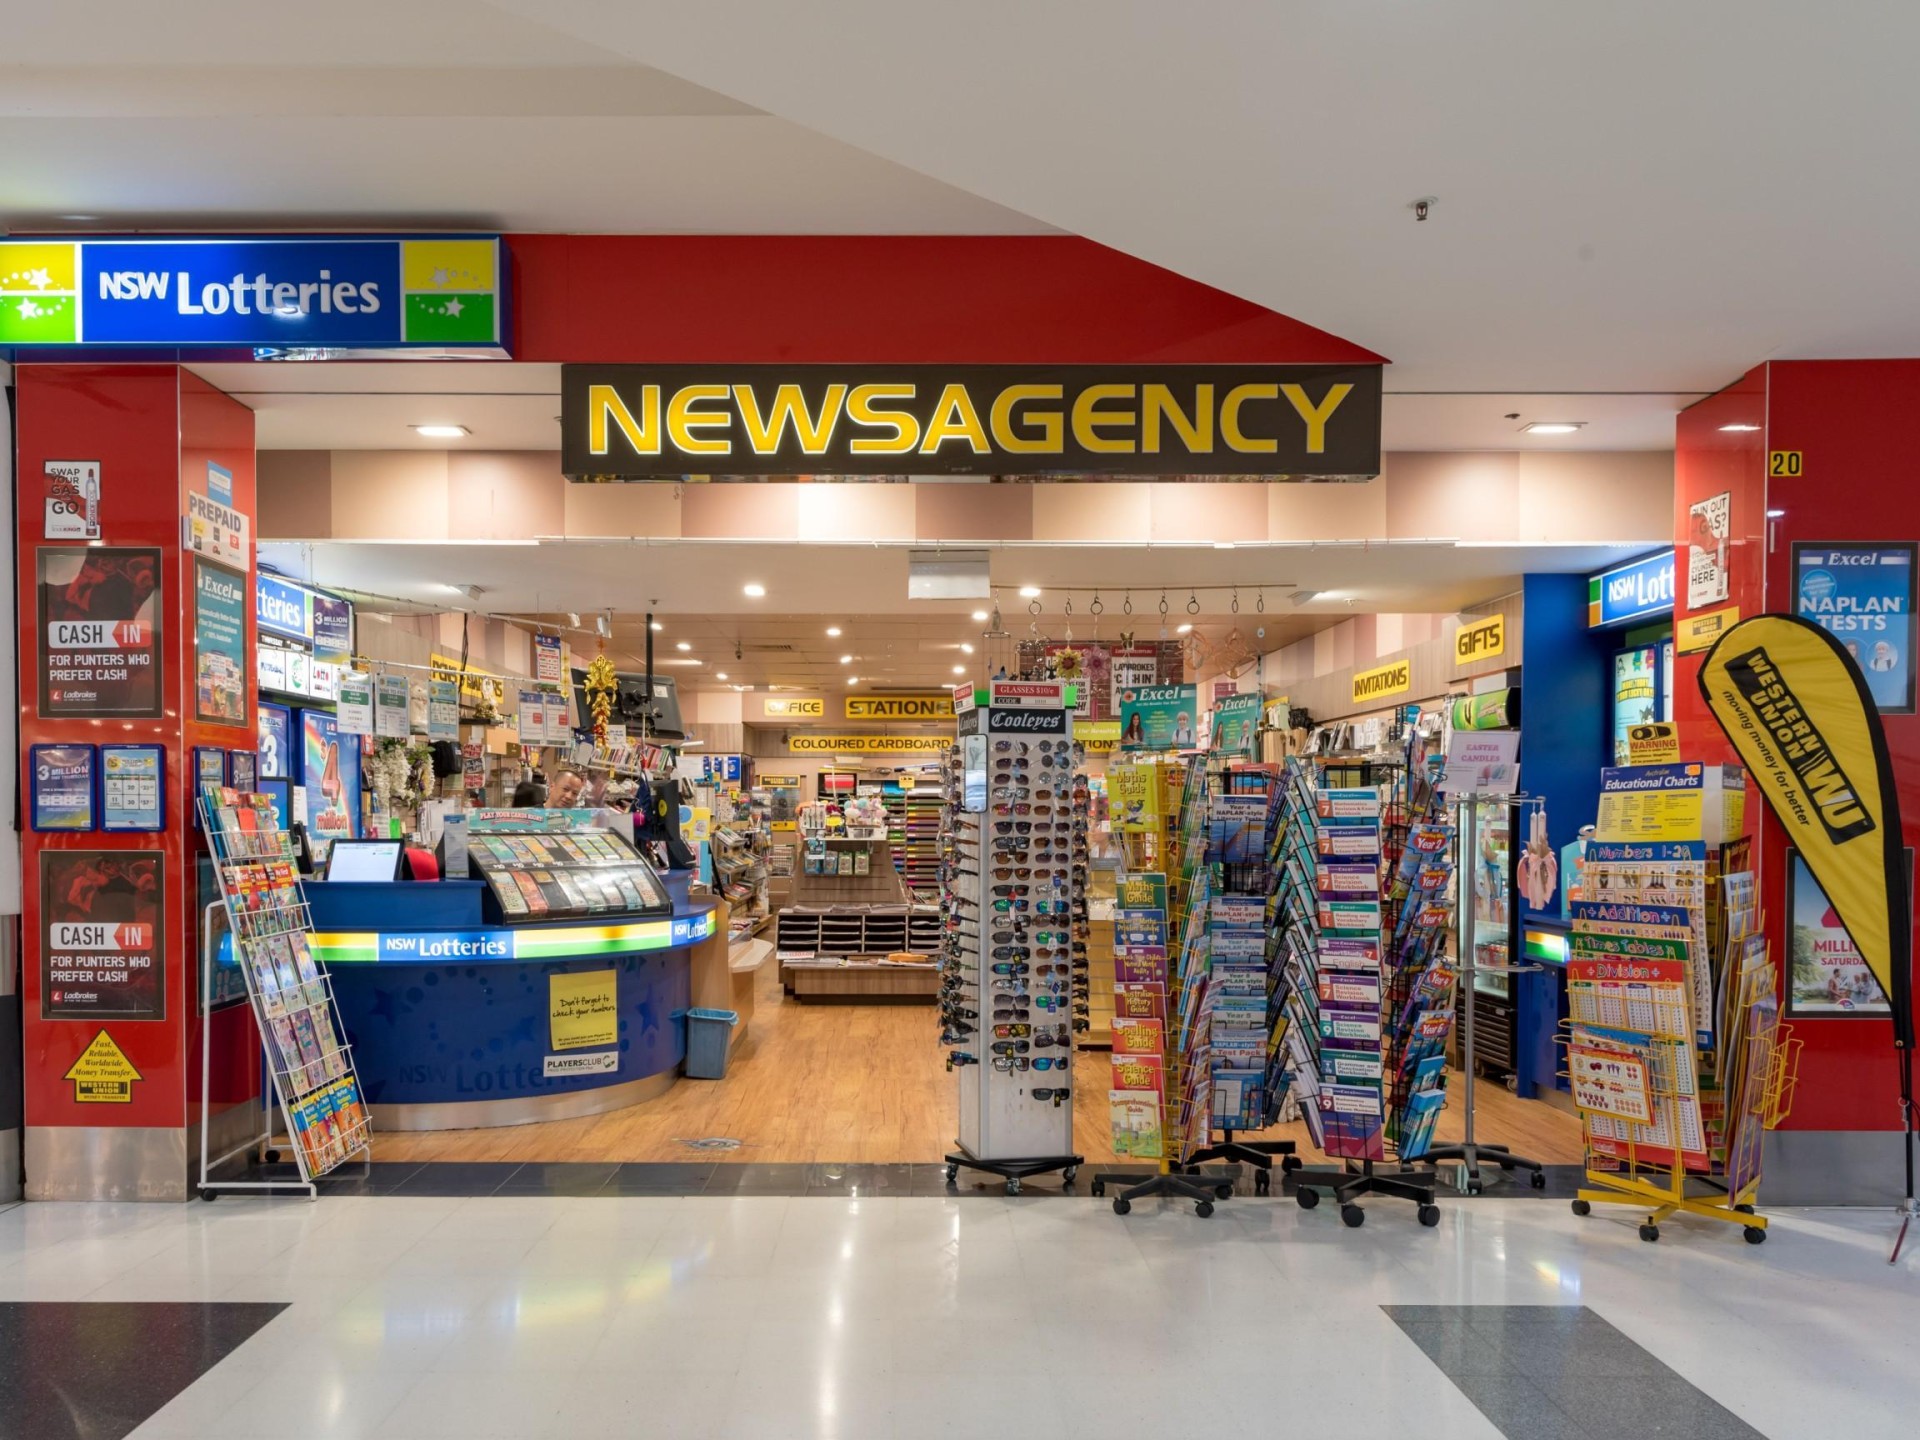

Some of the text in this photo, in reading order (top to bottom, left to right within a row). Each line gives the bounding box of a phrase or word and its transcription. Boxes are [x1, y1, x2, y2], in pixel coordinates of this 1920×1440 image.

[100, 269, 380, 315] NSW Lotteries
[589, 384, 1355, 455] NEWSAGENCY
[1772, 453, 1801, 475] 20
[50, 467, 80, 476] SWAP
[51, 476, 79, 485] YOUR
[52, 485, 80, 495] GAS
[52, 501, 80, 514] GO
[1710, 497, 1727, 513] OUT
[190, 496, 242, 533] PREPAID
[1700, 512, 1727, 535] GAS?
[1828, 552, 1878, 566] Excel
[1691, 569, 1715, 586] HERE
[204, 576, 234, 598] Excel
[1608, 574, 1635, 603] NSW
[314, 612, 323, 625] 3
[1815, 614, 1887, 631] TESTS
[58, 625, 141, 644] CASH IN
[1458, 623, 1500, 656] GIFTS
[49, 654, 150, 666] FOR PUNTERS WHO
[49, 669, 127, 680] PREFER CASH!
[312, 665, 329, 682] LOTTO
[1354, 666, 1407, 697] INVITATIONS
[1000, 686, 1034, 694] GLASSES
[1139, 686, 1179, 701] Excel
[768, 702, 821, 713] OFFICE
[1224, 698, 1248, 712] Excel
[1747, 653, 1821, 753] WESTERN
[991, 712, 1061, 731] Cooleyes
[1750, 692, 1806, 760] UNION
[793, 739, 951, 749] COLOURED CARDBOARD
[1630, 739, 1677, 749] WARNING
[262, 735, 278, 777] 3
[1722, 691, 1810, 827] moving money for better
[38, 765, 89, 780] 3 MILLION
[1116, 772, 1147, 784] Maths
[1604, 775, 1698, 790] Educational Charts
[1119, 784, 1146, 795] Guide
[1803, 757, 1866, 829] WU
[1322, 806, 1331, 816] 7
[316, 810, 348, 830] million
[1323, 843, 1331, 853] 7
[1417, 838, 1443, 850] Year 2
[1598, 844, 1653, 860] Numbers
[1127, 881, 1154, 892] Maths
[1321, 879, 1329, 889] 7
[1421, 876, 1436, 888] Year
[1127, 892, 1152, 903] Guide
[1422, 913, 1436, 925] Year
[1600, 906, 1660, 923] Addition
[674, 924, 687, 936] NSW
[60, 927, 142, 946] CASH IN
[386, 935, 507, 958] NSW Lotteries
[1584, 936, 1664, 956] Times Tables
[1322, 950, 1373, 959] SmartStudy 7
[50, 956, 150, 967] FOR PUNTERS WHO
[1332, 957, 1364, 969] English
[50, 971, 128, 982] PREFER CASH!
[1596, 964, 1650, 979] Division
[1430, 973, 1442, 985] Year
[1322, 988, 1331, 998] 7
[559, 994, 610, 1007] Don't forget to
[552, 1007, 575, 1018] check
[576, 1008, 590, 1019] your
[1129, 1005, 1149, 1013] Guide
[1117, 1023, 1158, 1037] Spelling
[1323, 1025, 1332, 1036] 9
[1421, 1022, 1443, 1034] Year 6
[1127, 1037, 1155, 1048] Guide
[85, 1059, 123, 1067] Worldwide
[547, 1057, 602, 1068] PLAYERSCLUB
[75, 1068, 98, 1078] Money
[399, 1065, 447, 1084] NSW
[1116, 1064, 1155, 1075] Science
[1123, 1075, 1151, 1086] Guide
[1127, 1106, 1144, 1114] Guide
[1322, 1099, 1332, 1110] 9
